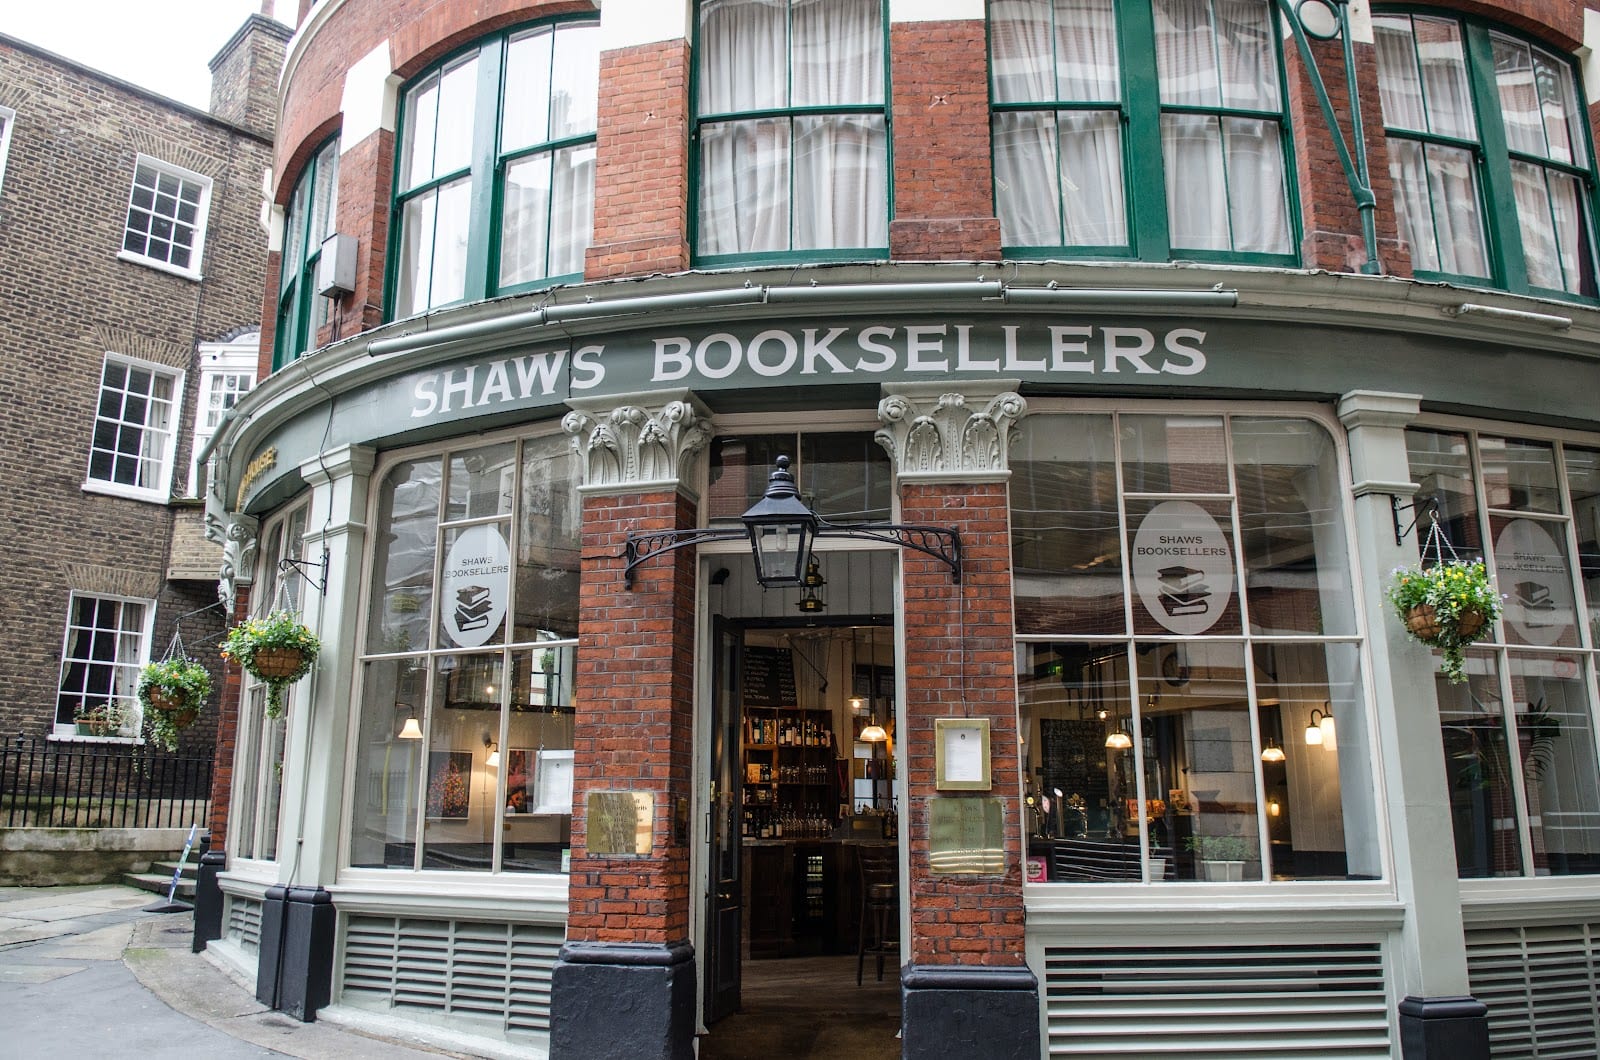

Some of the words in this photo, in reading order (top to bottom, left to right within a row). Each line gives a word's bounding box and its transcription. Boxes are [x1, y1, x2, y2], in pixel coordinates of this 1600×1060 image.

[409, 345, 605, 419] SHAWS
[651, 325, 1207, 382] BOOKSELLERS
[1159, 535, 1203, 544] SHAWS
[1137, 547, 1227, 556] BOOKSELLERS
[462, 556, 493, 566] SHAWS
[1513, 552, 1545, 561] SHAWS
